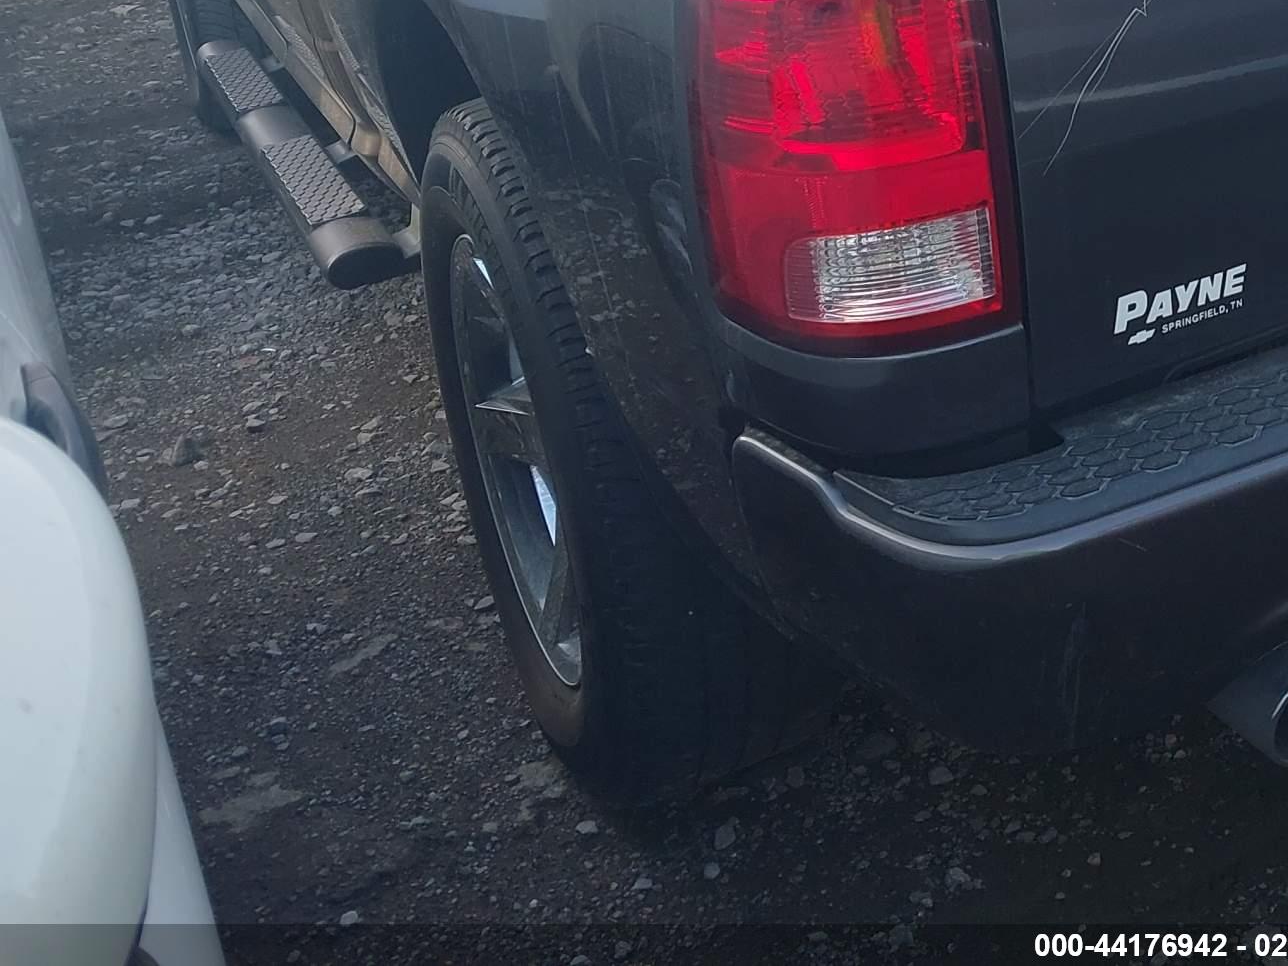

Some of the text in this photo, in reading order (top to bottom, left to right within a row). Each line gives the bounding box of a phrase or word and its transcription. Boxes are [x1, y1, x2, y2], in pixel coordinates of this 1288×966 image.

[1113, 263, 1247, 335] PAYNE
[1161, 298, 1244, 334] SPRINGFIELD, TN
